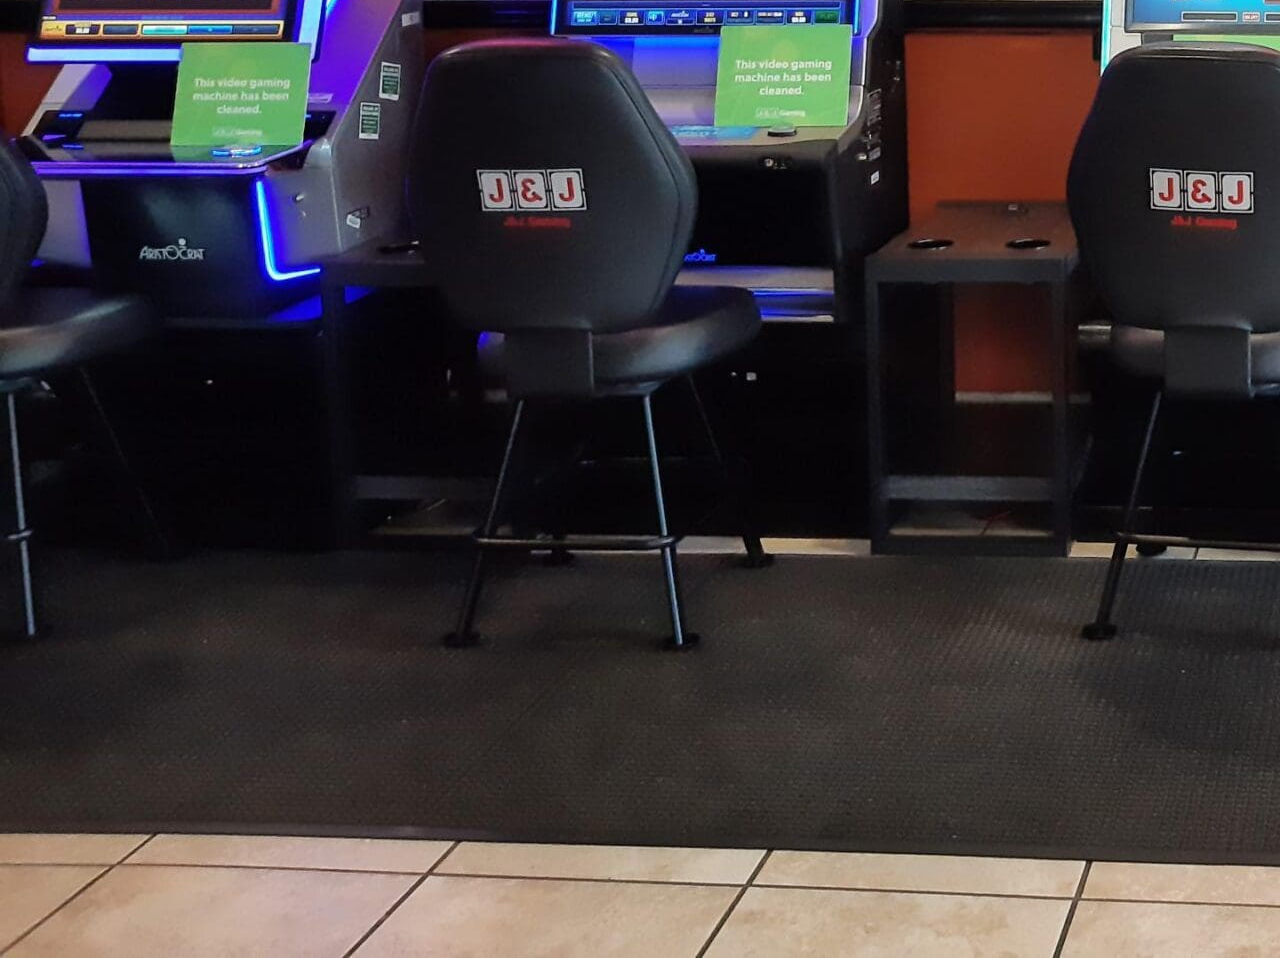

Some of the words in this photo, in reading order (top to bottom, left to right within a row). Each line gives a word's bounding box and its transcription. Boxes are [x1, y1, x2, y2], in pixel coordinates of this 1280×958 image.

[735, 59, 757, 69] This
[759, 59, 788, 69] video
[791, 59, 832, 71] gaming
[735, 73, 781, 83] machine
[783, 73, 802, 82] has
[804, 72, 832, 82] been
[194, 77, 215, 88] This
[217, 77, 247, 88] video
[249, 78, 291, 90] gaming
[193, 90, 239, 101] machine
[241, 90, 259, 101] has
[261, 90, 289, 101] been
[759, 85, 804, 96] cleaned.
[217, 104, 262, 115] cleaned.
[489, 177, 576, 203] J&J
[1158, 177, 1245, 205] J&J
